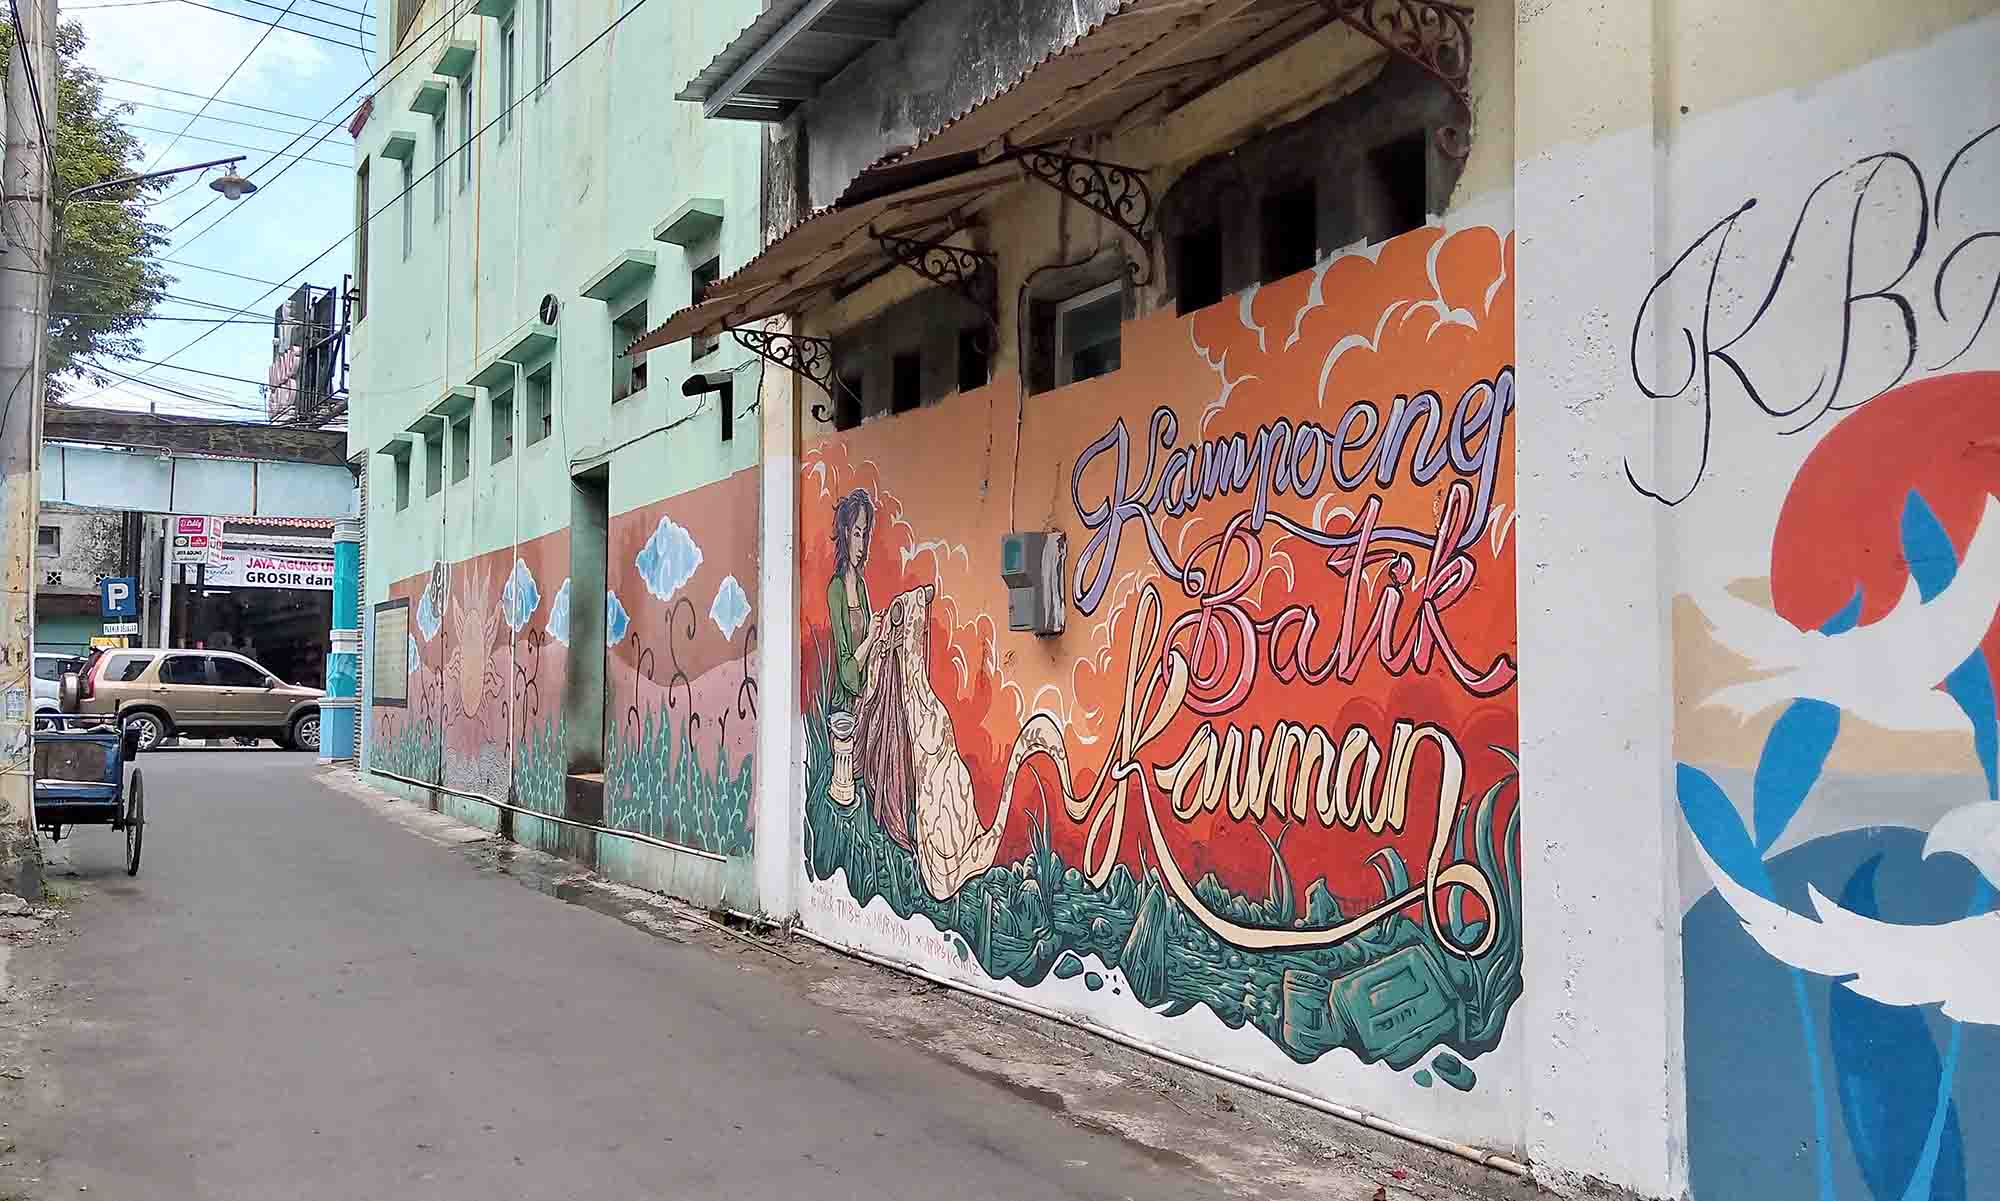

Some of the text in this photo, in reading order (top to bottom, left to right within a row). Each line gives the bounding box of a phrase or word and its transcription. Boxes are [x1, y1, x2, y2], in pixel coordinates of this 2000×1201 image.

[1072, 366, 1515, 617] Kampoeng
[108, 583, 129, 610] P
[246, 558, 275, 569] JAYA
[277, 560, 320, 571] AGUNG
[246, 571, 302, 585] GROSIR
[305, 574, 333, 586] dan
[1161, 481, 1518, 716] Batik
[1083, 583, 1498, 959] Kauman
